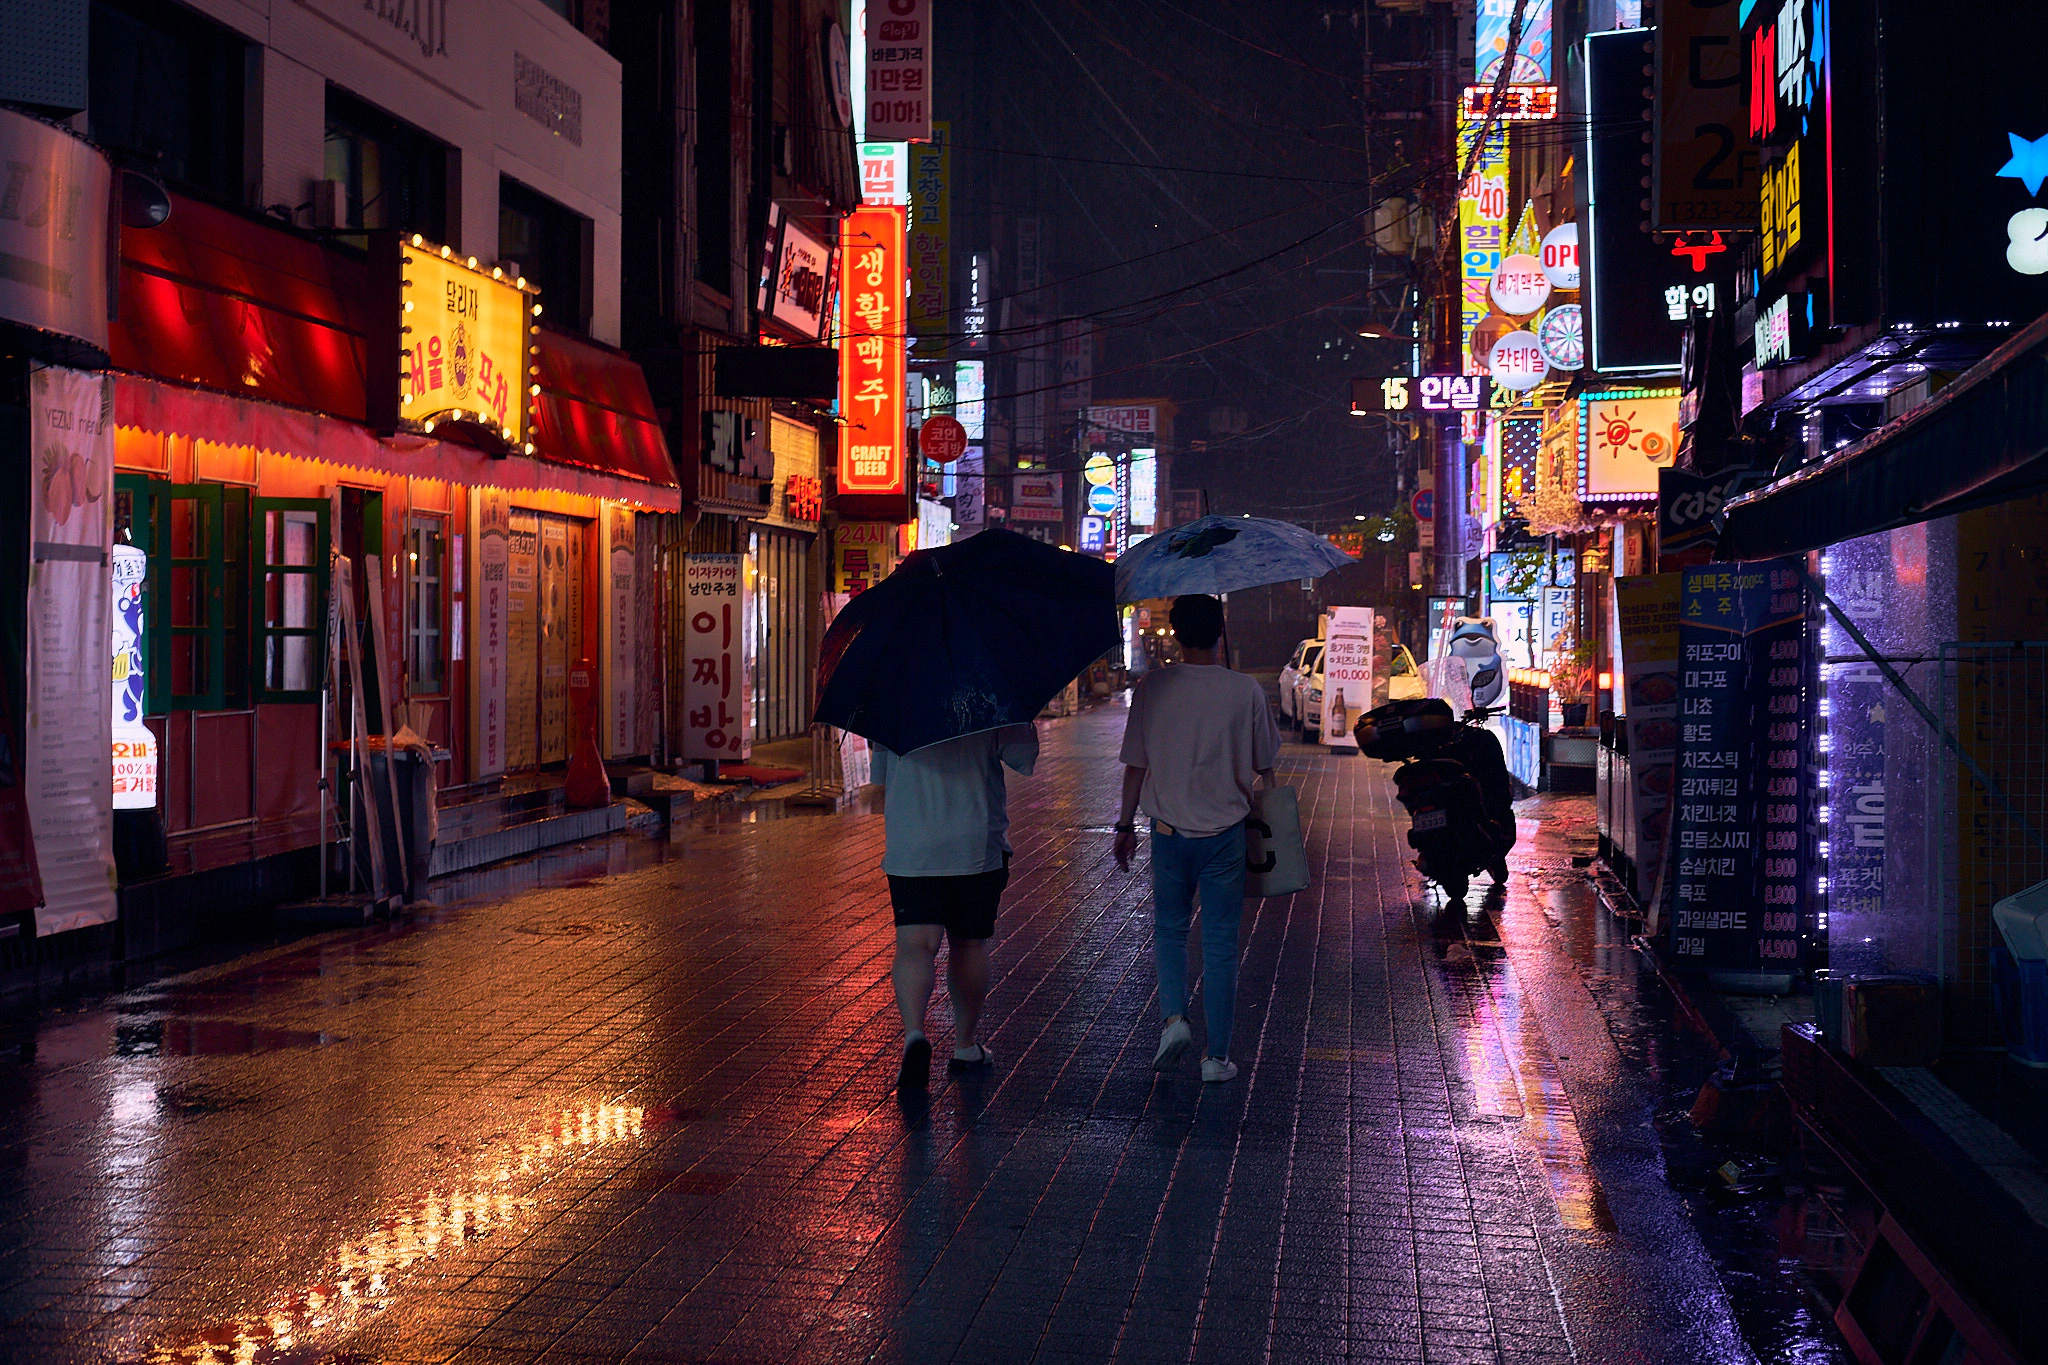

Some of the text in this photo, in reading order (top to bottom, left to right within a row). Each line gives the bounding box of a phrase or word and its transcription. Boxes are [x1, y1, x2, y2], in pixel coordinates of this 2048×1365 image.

[871, 47, 923, 62] 바른가격
[871, 69, 922, 91] 1만원
[871, 100, 922, 124] 이하!
[1760, 140, 1801, 277] 할인점
[916, 233, 944, 321] 할인점
[1496, 273, 1545, 296] 세계맥주
[446, 280, 478, 321] 달리자
[854, 247, 890, 417] 생활맥주
[1497, 347, 1545, 374] 칵테일
[410, 335, 509, 427] 서울 포차
[1380, 377, 1409, 410] 15
[1419, 376, 1481, 410] 인실
[931, 427, 957, 441] 코인
[850, 445, 892, 461] CRAFT
[927, 441, 961, 457] 노래방
[854, 461, 887, 476] BEER
[839, 525, 884, 544] 24시
[1081, 516, 1103, 543] P
[688, 566, 737, 579] 이자카야
[688, 582, 737, 596] 낭만주점
[1688, 573, 1732, 594] 생맥주
[1329, 642, 1354, 654] 호가든
[1685, 643, 1742, 662] 쥐포구이
[690, 603, 734, 749] 이찌방
[1684, 669, 1728, 689] 대구포
[1682, 723, 1713, 743] 황도
[1682, 750, 1739, 770] 치즈스틱
[1842, 742, 1874, 759] 안주
[1681, 777, 1738, 797] 감자튀김
[1680, 803, 1737, 823] 치킨너겟
[1679, 830, 1750, 850] 모듬소시지
[1679, 857, 1736, 877] 순살치킨
[1837, 866, 1882, 892] 포켓
[1678, 884, 1707, 903] 육포
[1677, 910, 1748, 930] 과일샐러드
[1676, 937, 1705, 956] 과일
